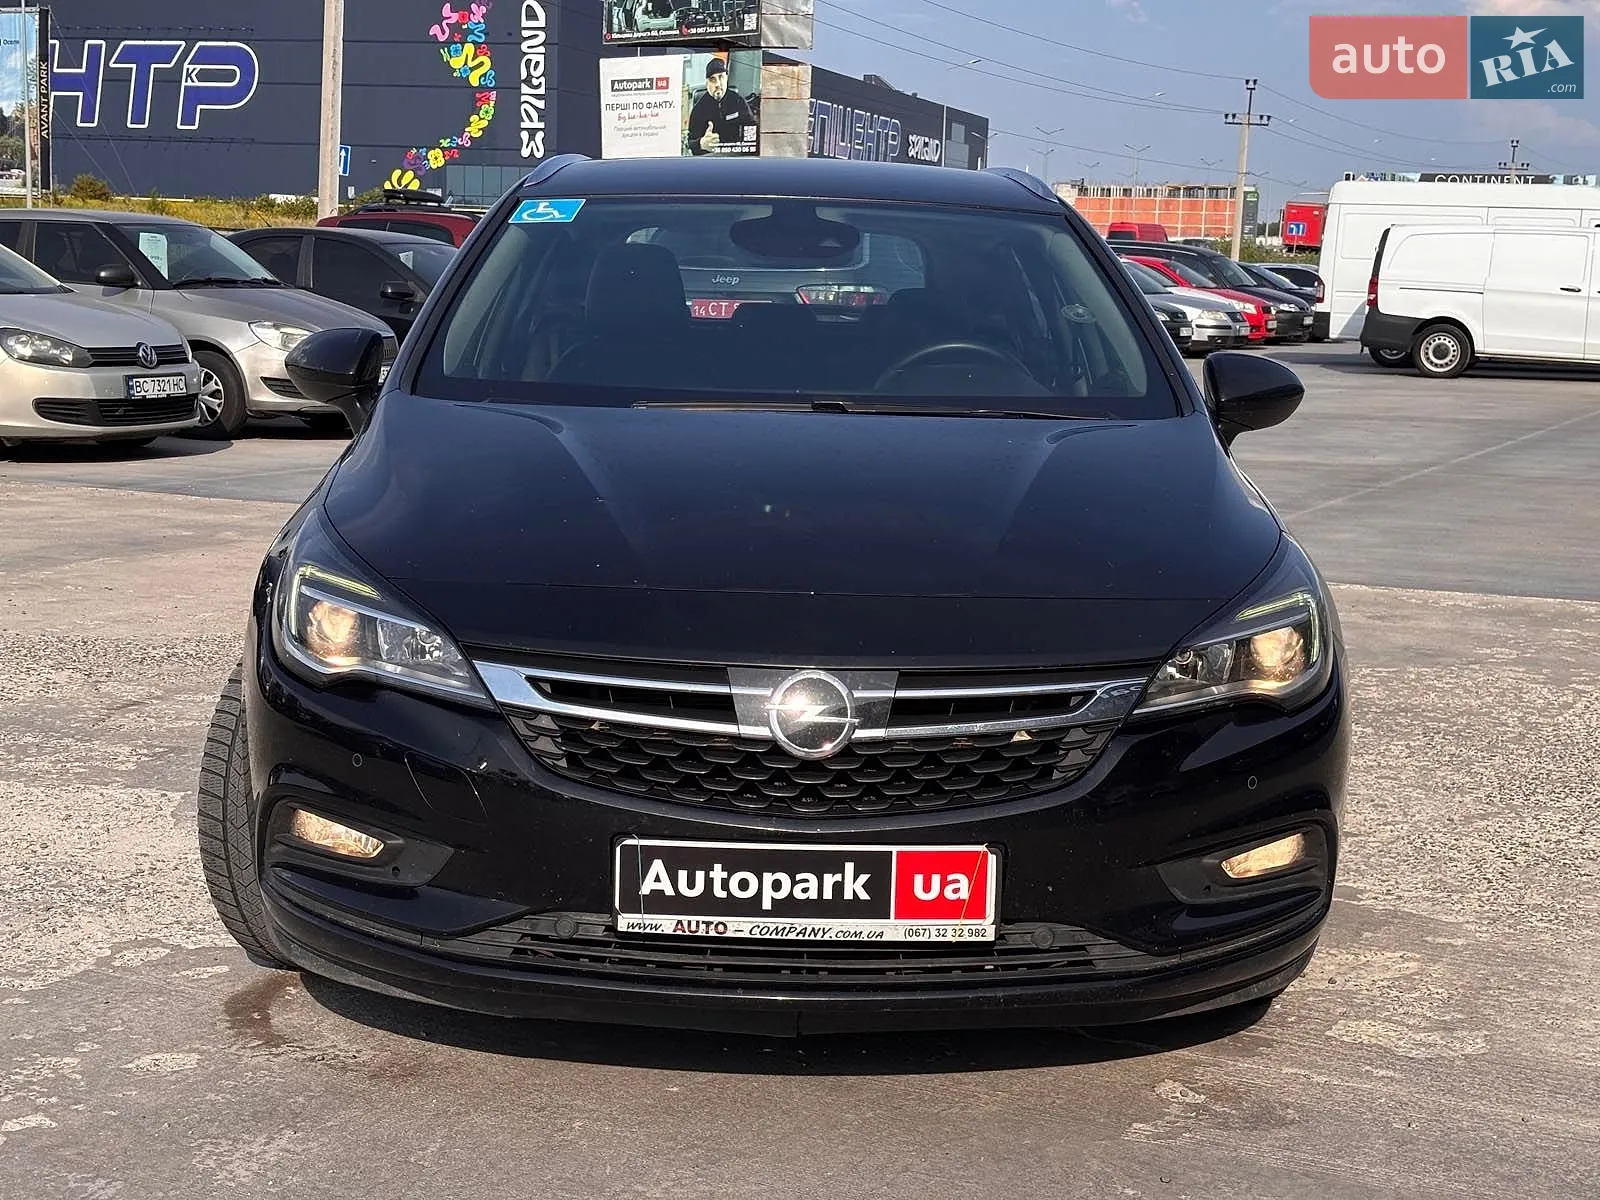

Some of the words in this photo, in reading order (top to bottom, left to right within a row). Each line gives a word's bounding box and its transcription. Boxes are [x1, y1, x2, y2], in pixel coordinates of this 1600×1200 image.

[40, 60, 48, 94] PARK
[614, 79, 651, 91] Autopark
[605, 103, 630, 111] ПЕРШІ
[632, 102, 644, 110] ПО
[646, 100, 676, 109] ФАКТУ.
[40, 96, 49, 139] AVANT
[1434, 174, 1536, 185] CONTINENT
[711, 274, 740, 285] Jeep
[151, 379, 171, 393] 7321
[640, 859, 872, 911] Autopark
[912, 872, 970, 902] ua
[626, 920, 665, 933] www.
[672, 919, 728, 935] AUTO
[903, 927, 932, 940] (067)
[934, 928, 948, 938] 32
[951, 928, 965, 938] 32
[967, 928, 987, 938] 982
